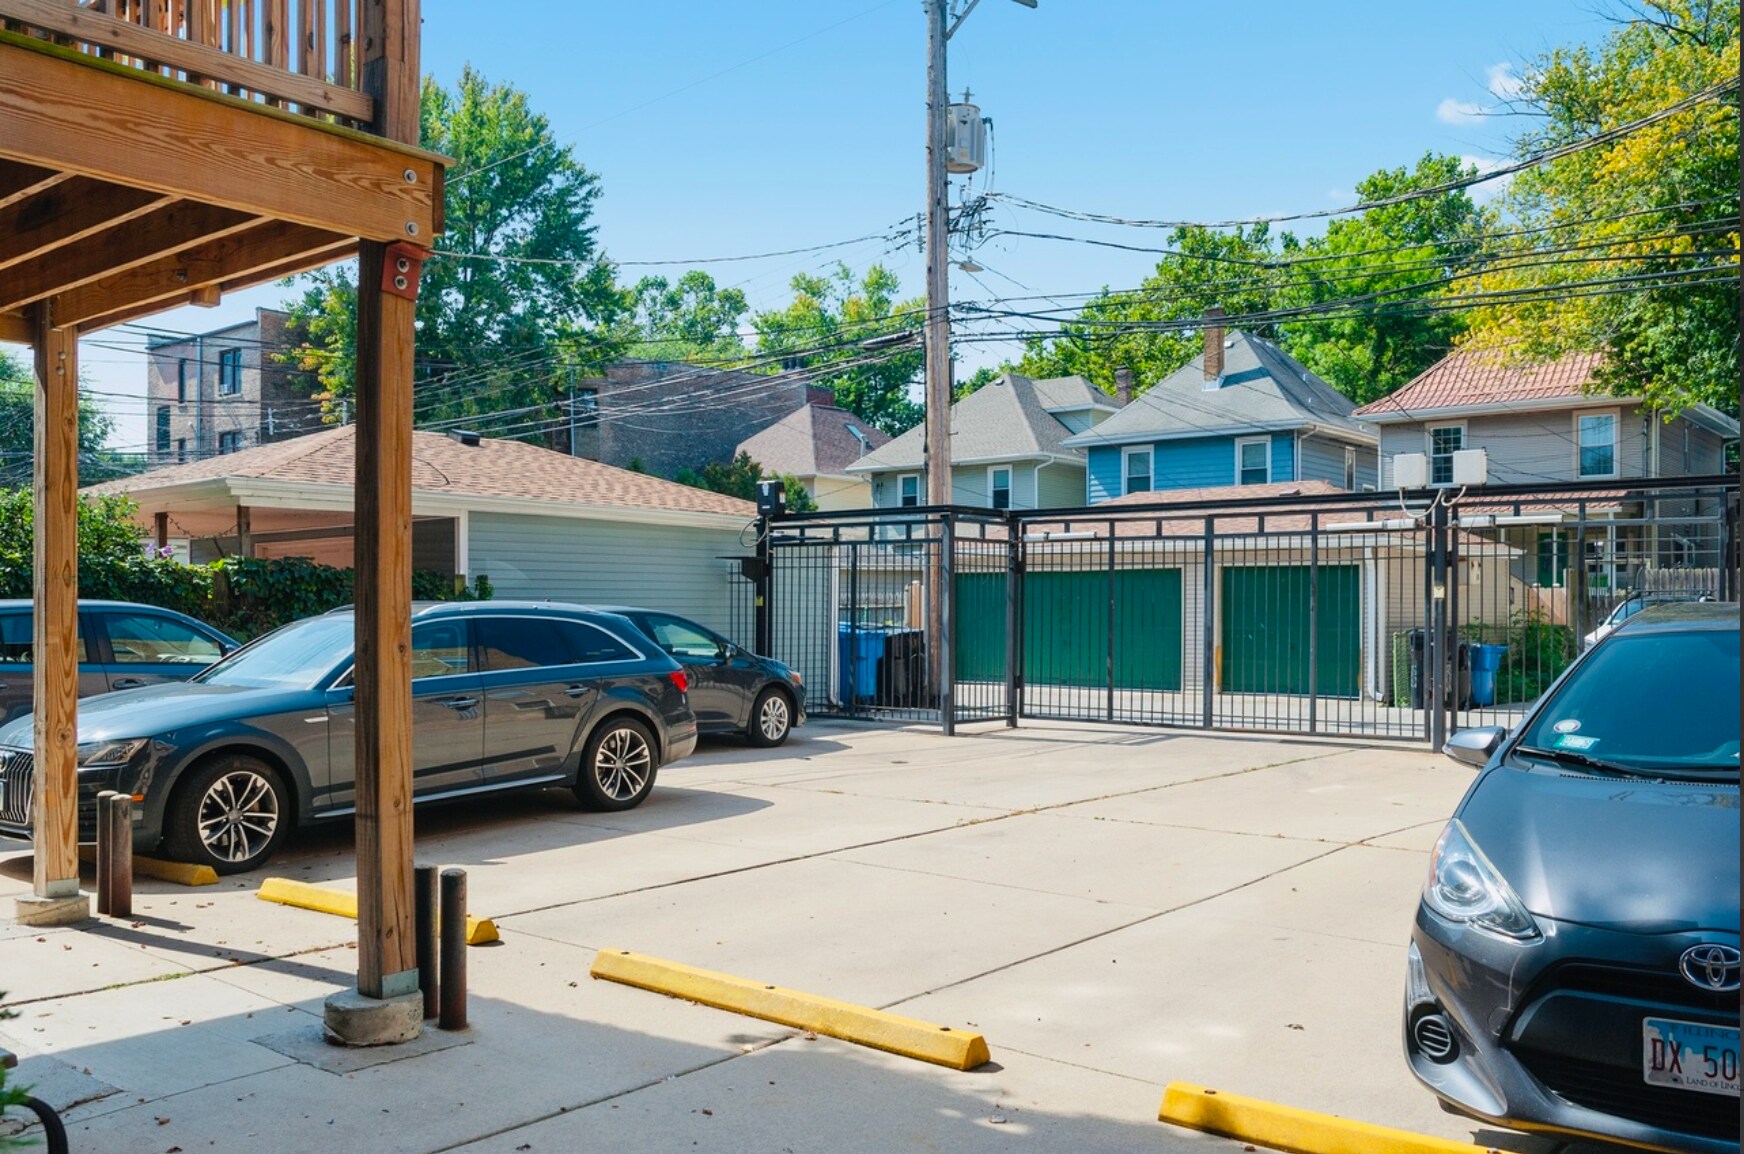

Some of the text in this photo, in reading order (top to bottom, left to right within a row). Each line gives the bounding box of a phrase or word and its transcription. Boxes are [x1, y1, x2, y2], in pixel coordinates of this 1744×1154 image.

[1652, 1039, 1740, 1080] DX 50
[1687, 1077, 1707, 1087] LAND
